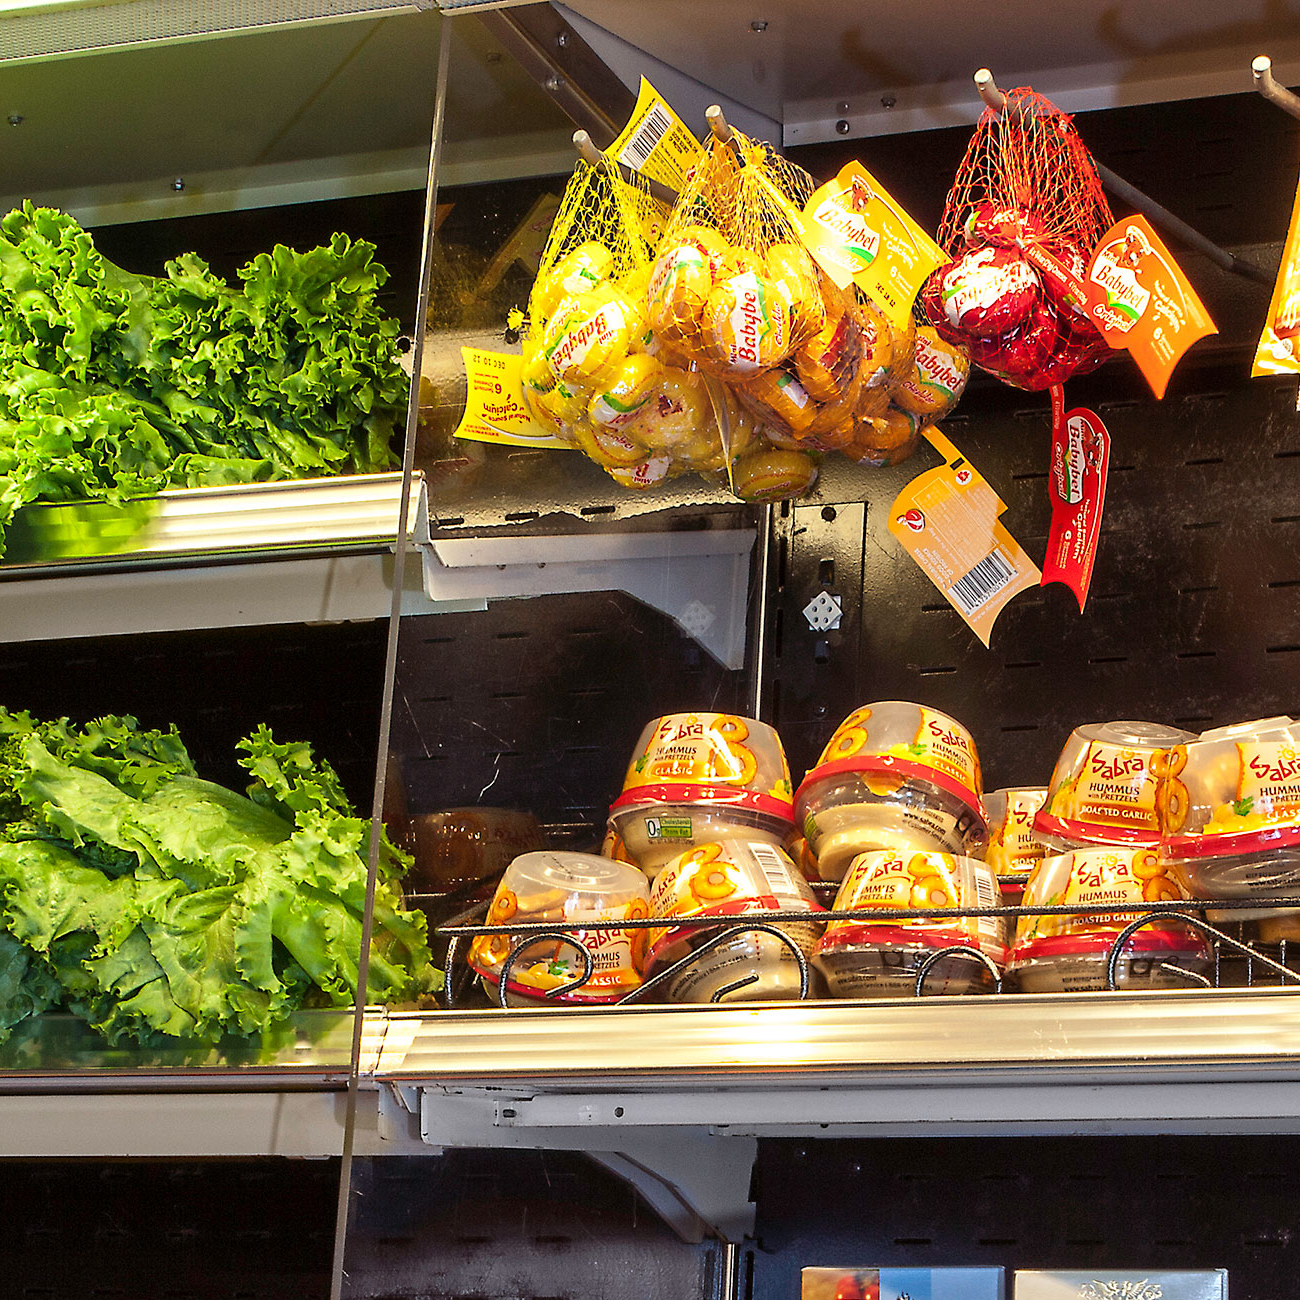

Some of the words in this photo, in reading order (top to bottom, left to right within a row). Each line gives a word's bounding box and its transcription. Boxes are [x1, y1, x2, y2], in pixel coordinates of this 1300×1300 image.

[1096, 265, 1145, 309] Babybel
[1093, 304, 1137, 333] Original
[551, 312, 606, 372] Babybel
[495, 383, 502, 394] 6
[483, 403, 517, 415] Calcium
[1054, 442, 1068, 500] Original
[1070, 425, 1080, 499] Babybel
[928, 721, 968, 751] Sabra
[656, 746, 697, 755] HUMMUS
[932, 742, 968, 766] HUMMUS
[934, 761, 966, 781] CLASSIC
[1091, 750, 1144, 780] Sabra
[1089, 782, 1140, 796] HUMMUS
[1100, 792, 1138, 803] PRETZELS
[1121, 810, 1152, 821] GARLIC
[1079, 890, 1127, 902] HUMMUS
[1073, 914, 1110, 926] ROASTED
